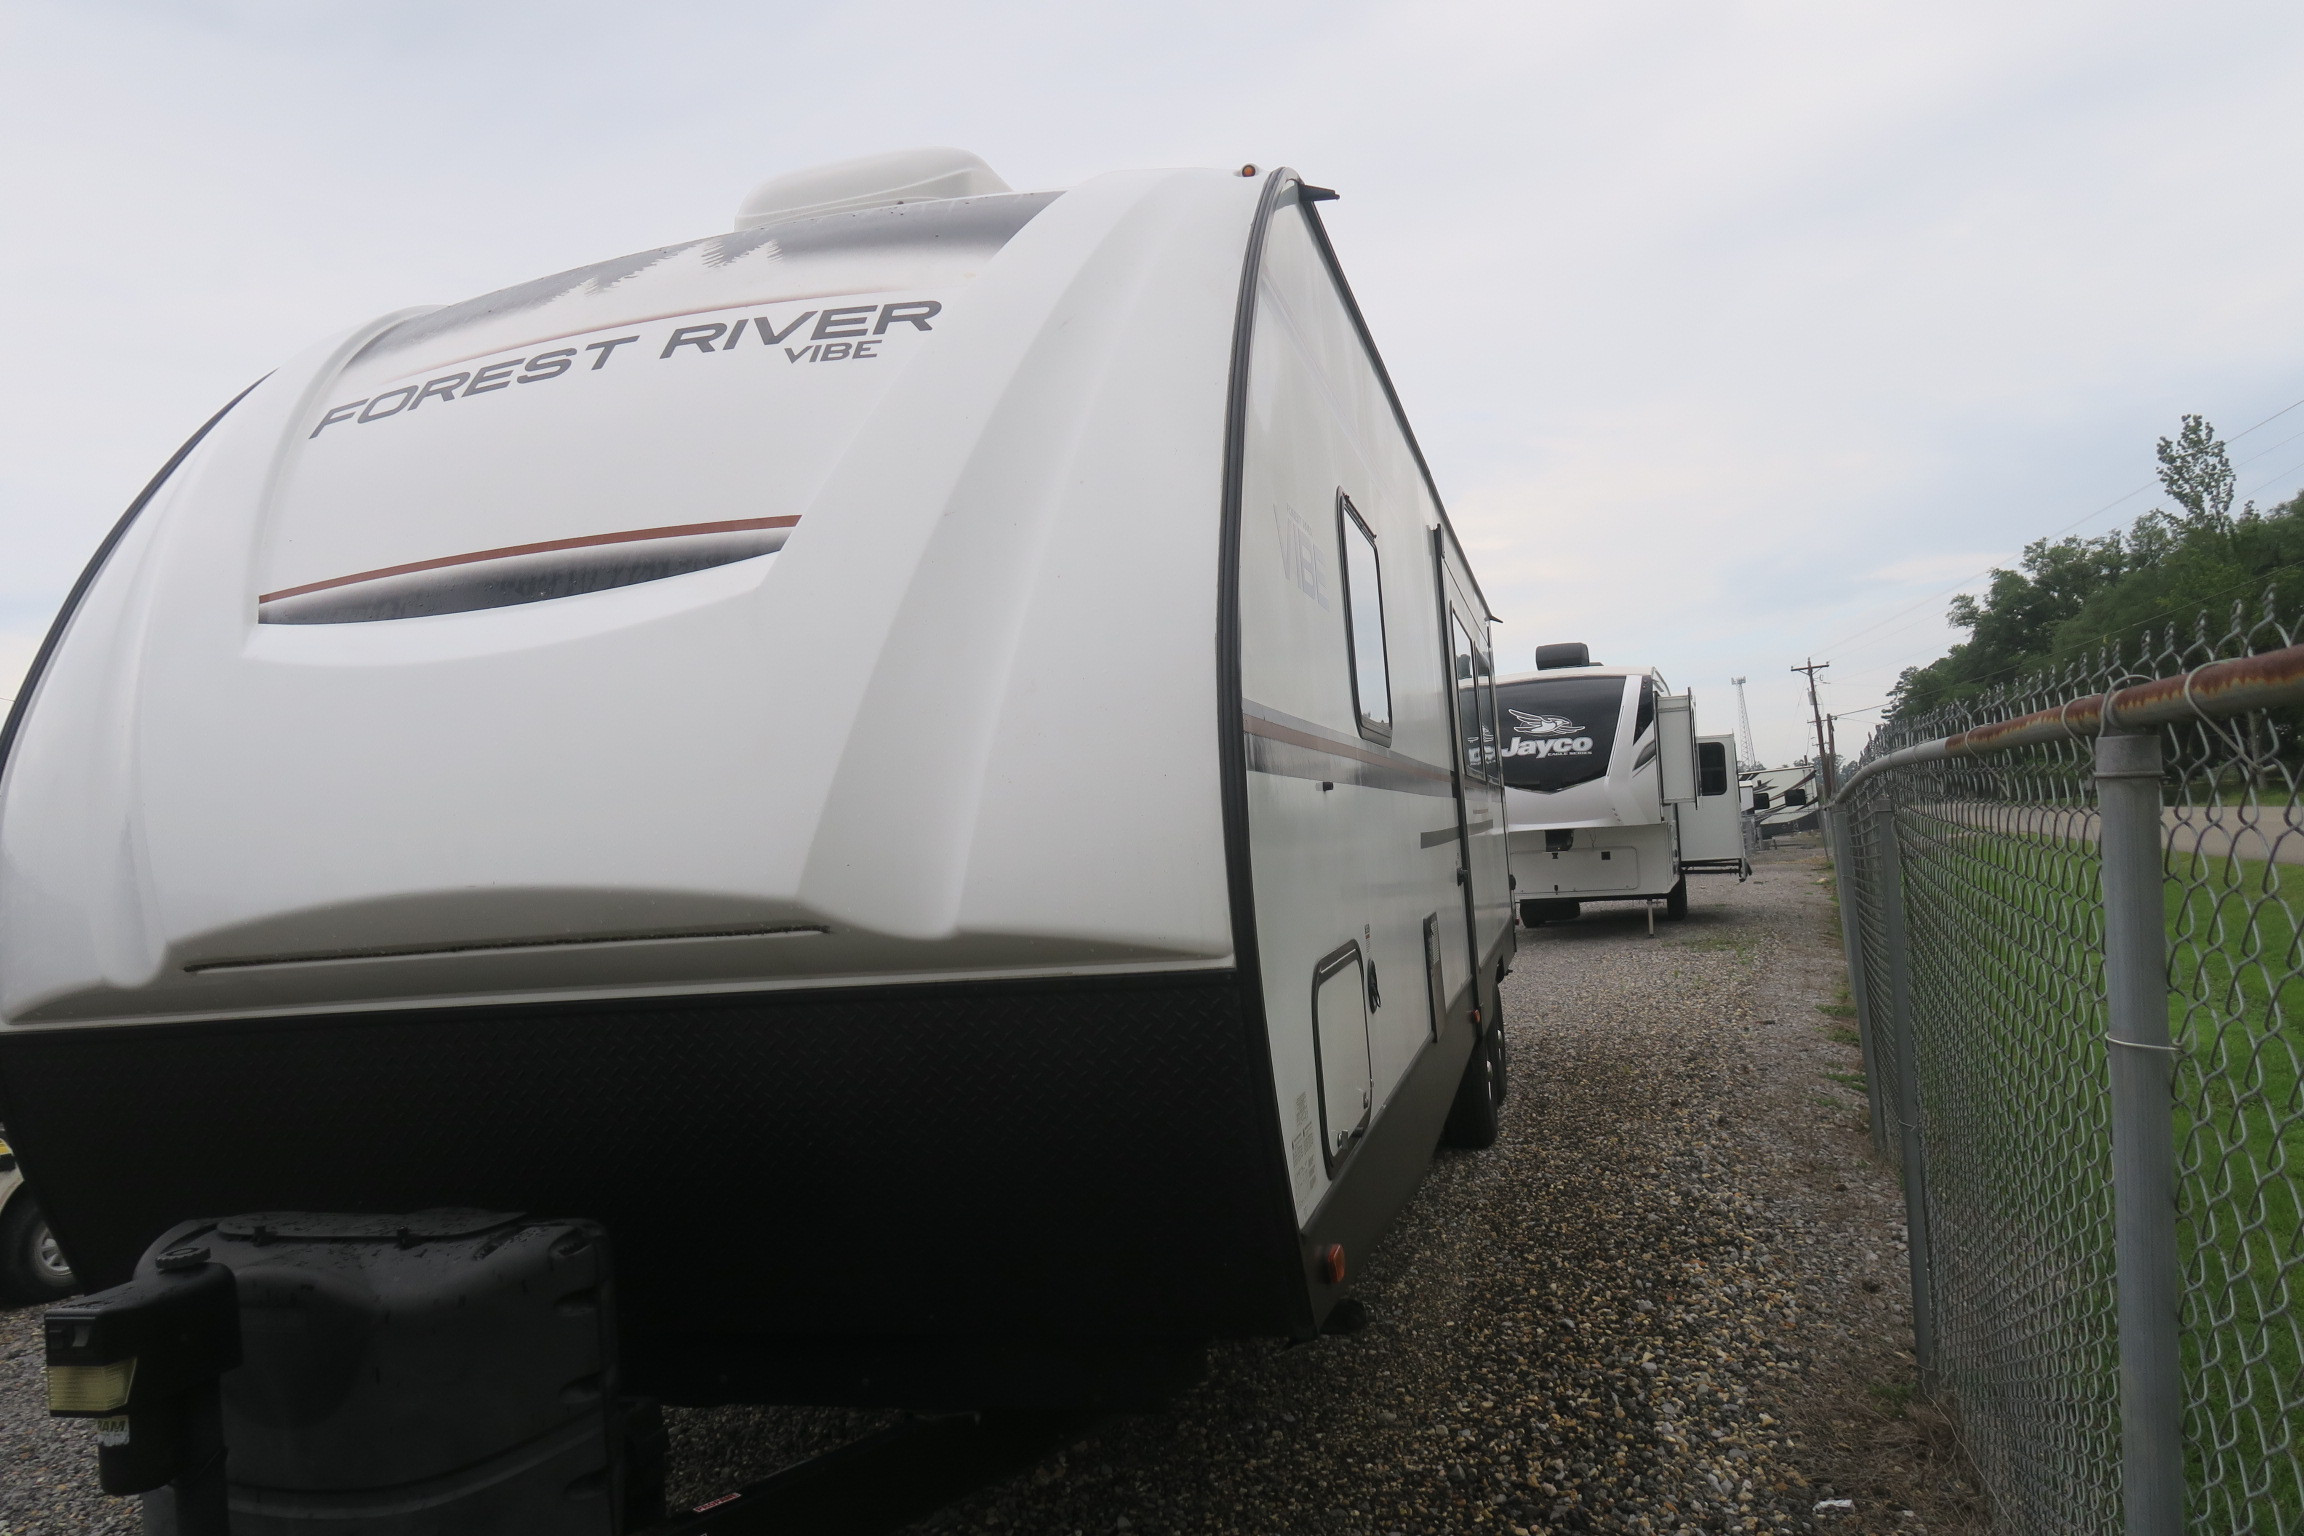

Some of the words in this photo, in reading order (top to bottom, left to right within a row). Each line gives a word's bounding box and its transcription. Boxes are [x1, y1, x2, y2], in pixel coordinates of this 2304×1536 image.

[309, 335, 640, 439] FOREST
[659, 300, 942, 359] RIVER
[783, 339, 883, 364] VIBE
[1273, 503, 1330, 612] VIBE
[1501, 736, 1594, 759] Jayco
